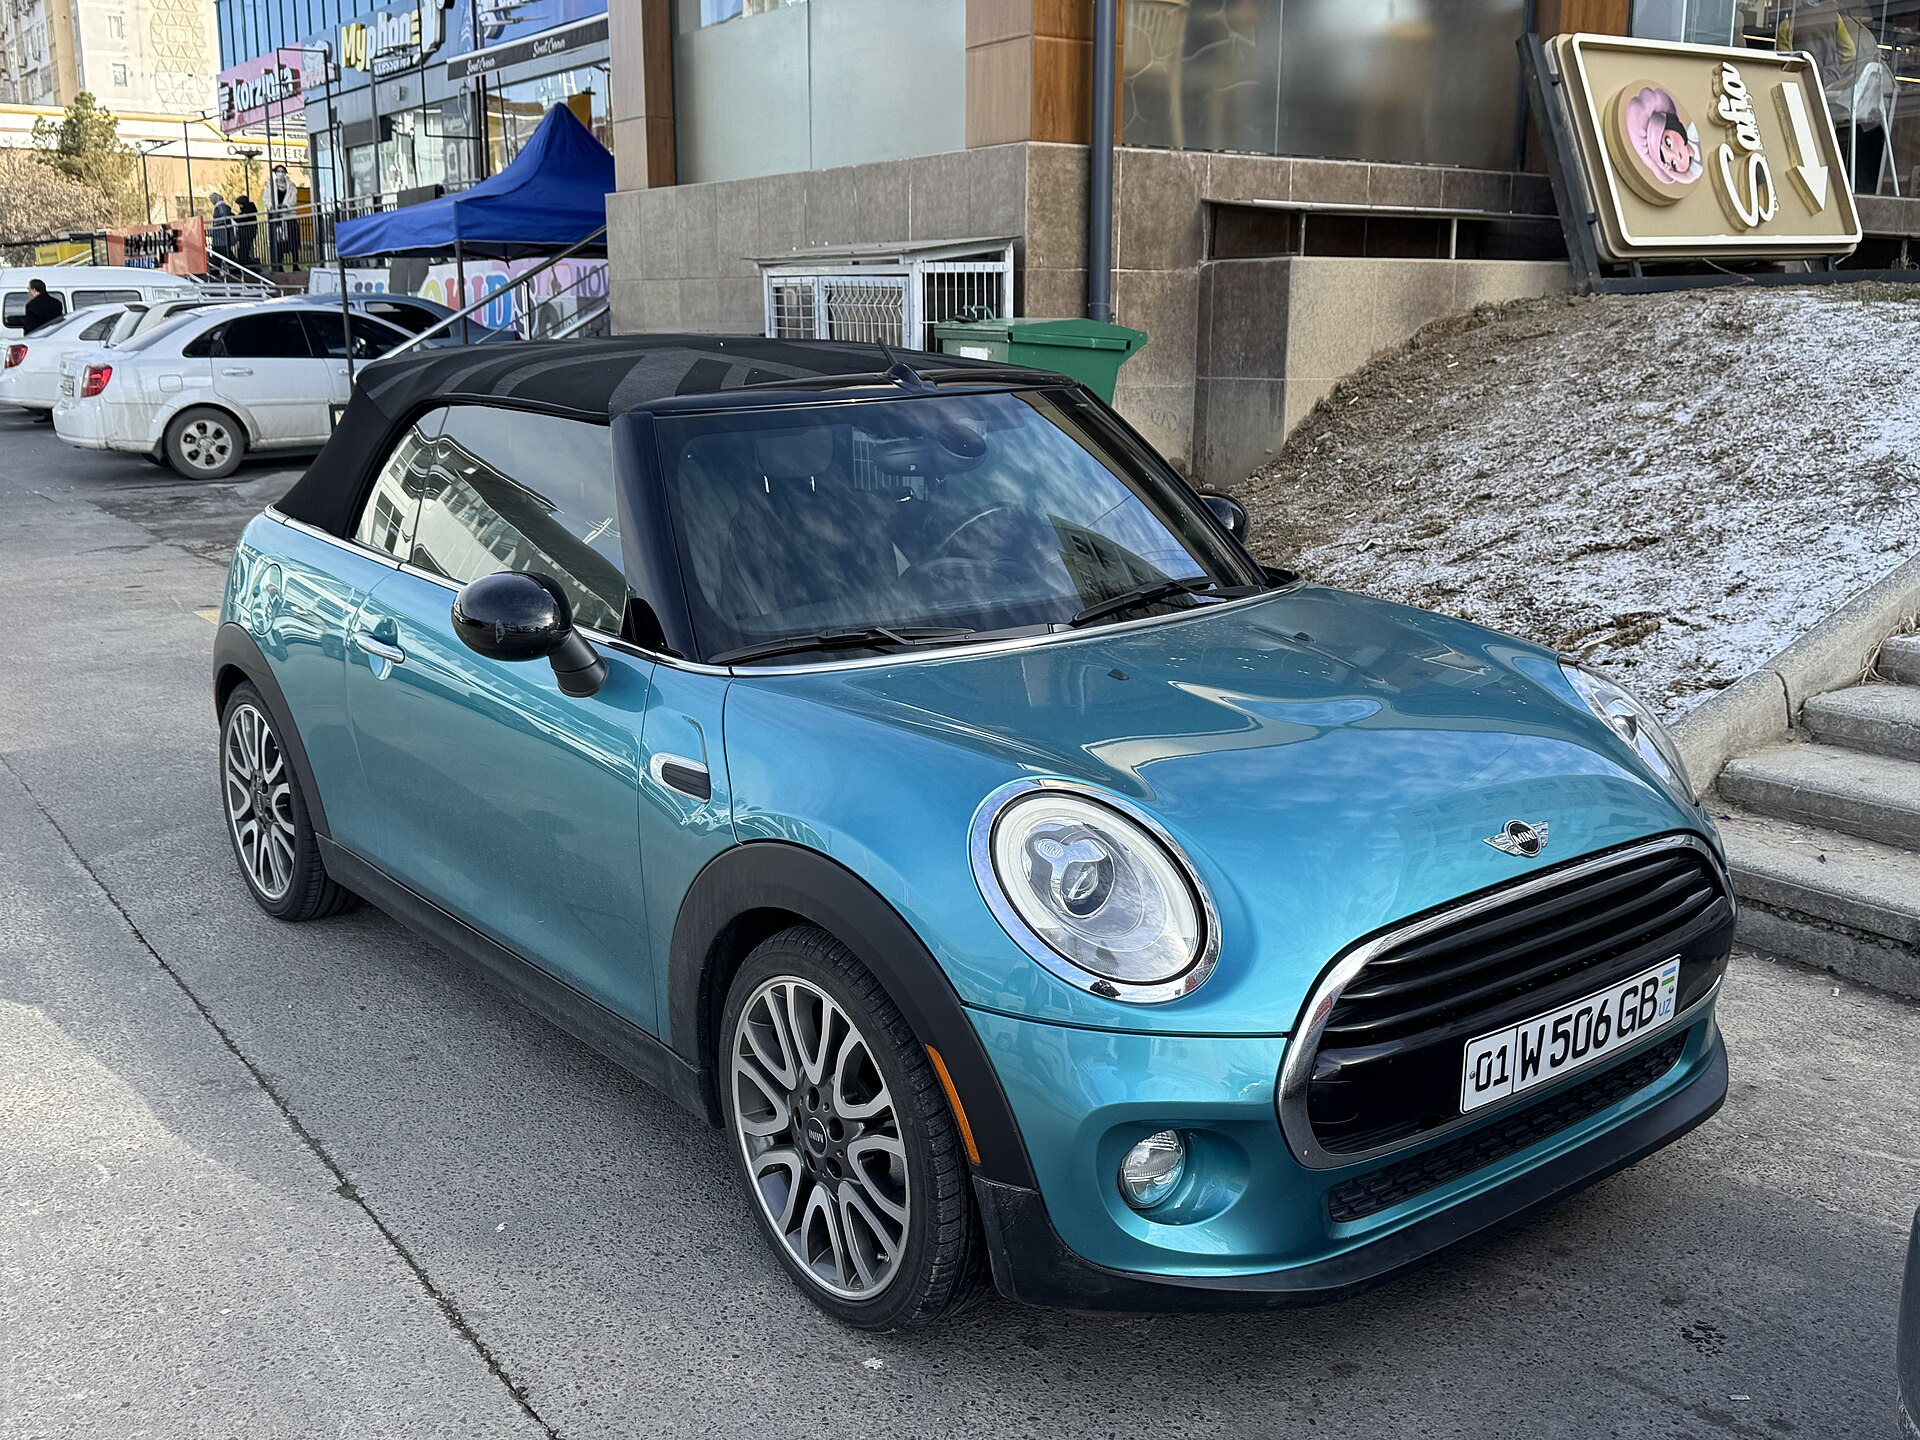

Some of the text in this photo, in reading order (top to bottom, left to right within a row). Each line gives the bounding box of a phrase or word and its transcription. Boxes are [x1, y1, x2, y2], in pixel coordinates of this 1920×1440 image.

[233, 64, 294, 112] korzinka
[1717, 62, 1775, 227] Safia
[1511, 829, 1537, 845] MINI
[1658, 998, 1672, 1017] UZ
[1475, 976, 1659, 1092] 01 W 506 GB
